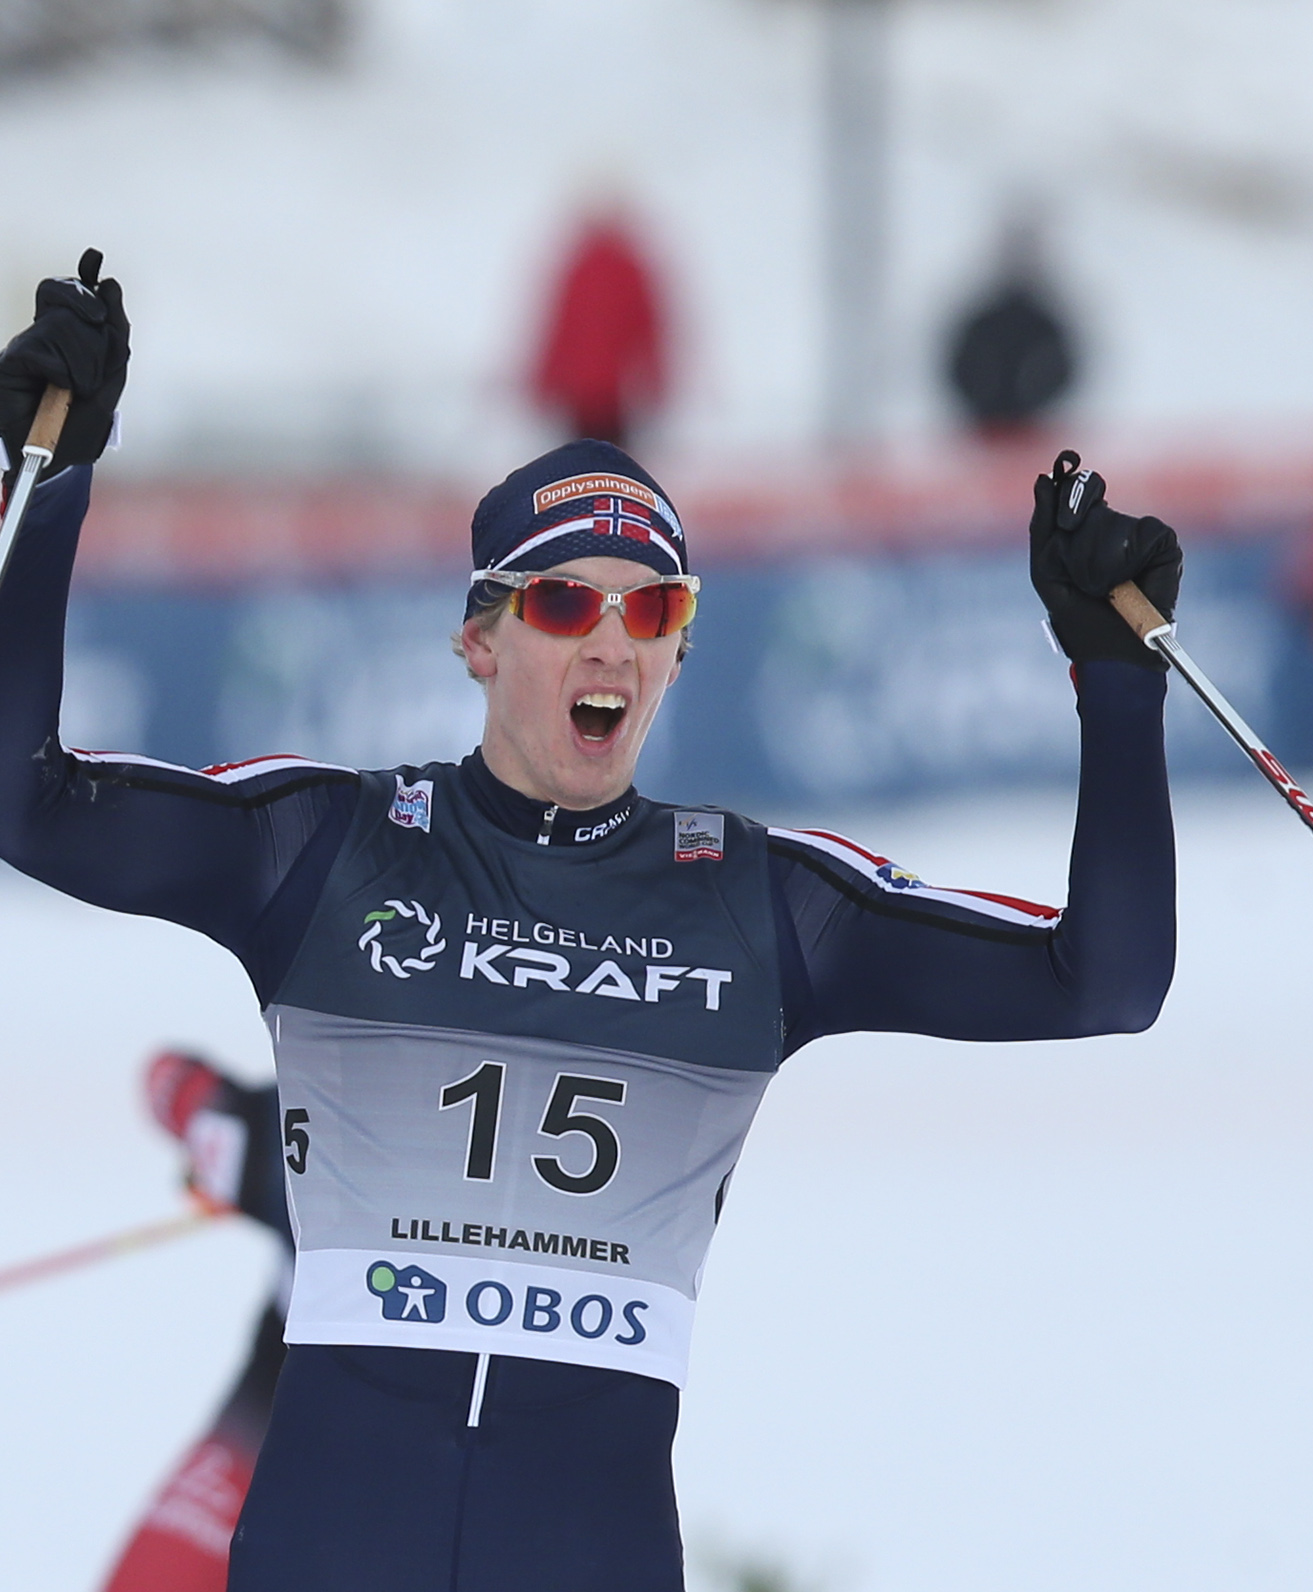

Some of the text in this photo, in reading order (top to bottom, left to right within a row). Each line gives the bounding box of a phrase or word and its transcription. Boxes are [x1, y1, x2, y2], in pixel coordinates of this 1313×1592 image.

[465, 912, 674, 959] HELGELAND
[459, 940, 733, 1011] KRAFT
[439, 1060, 628, 1197] 15
[390, 1217, 631, 1265] LILLEHAMMER
[465, 1280, 650, 1345] OBOS
